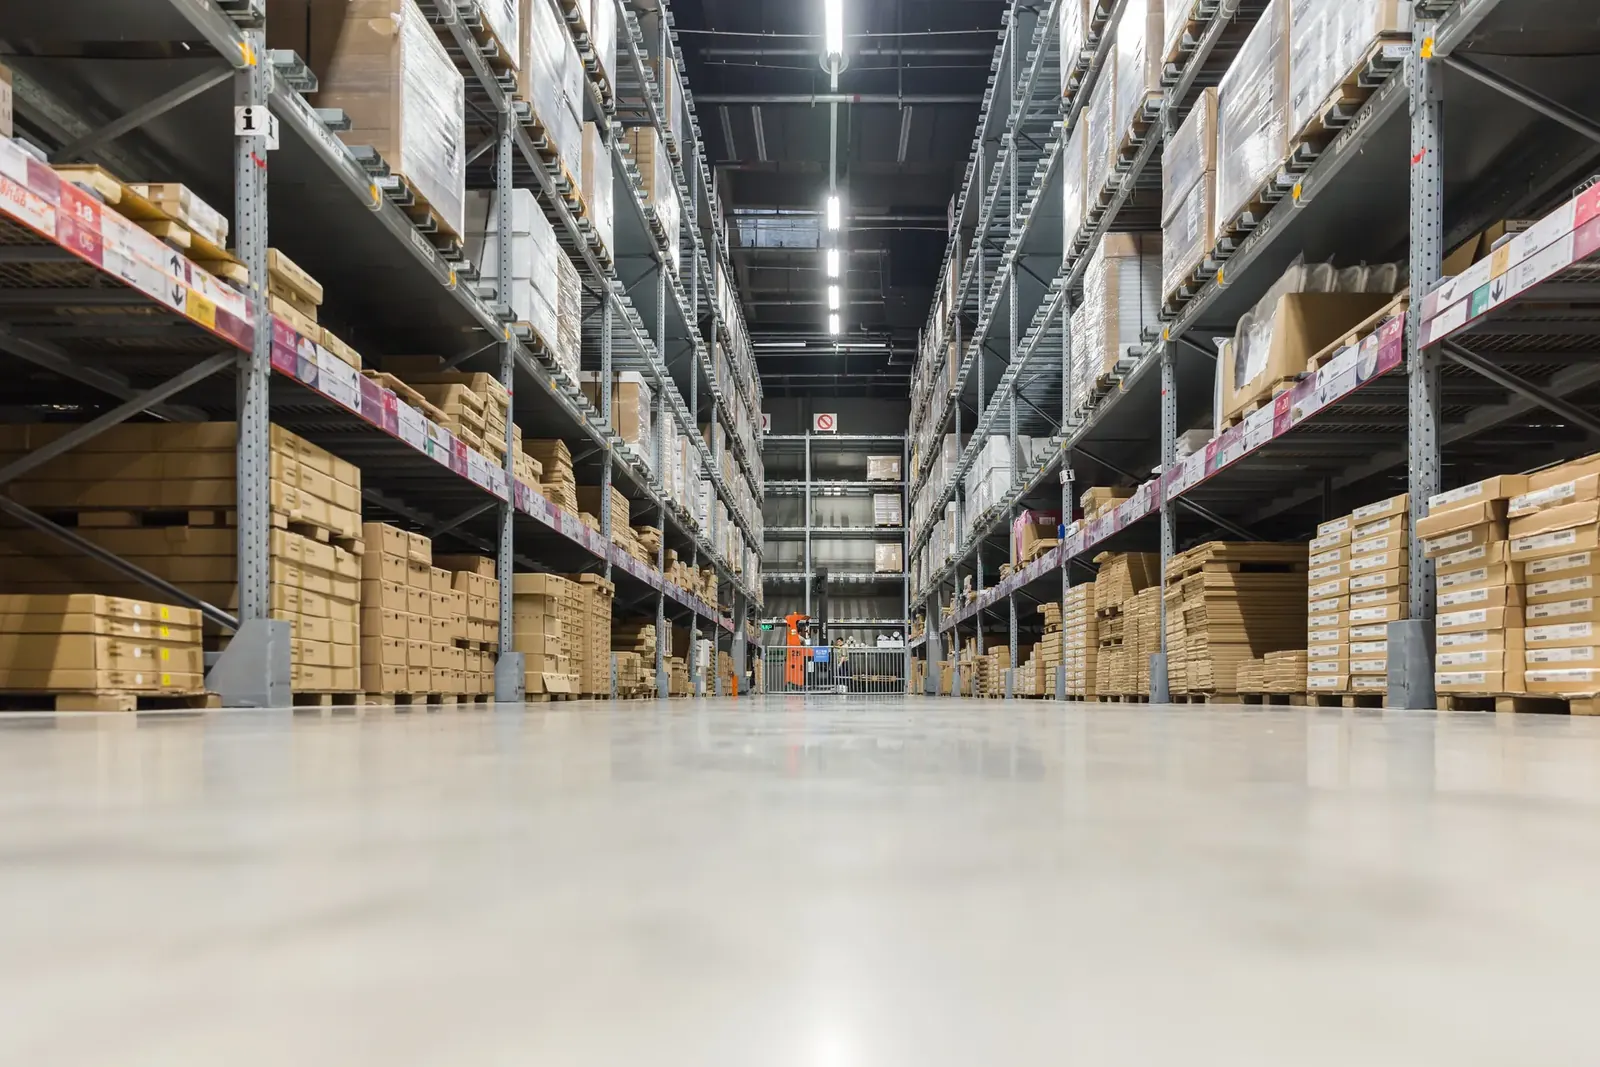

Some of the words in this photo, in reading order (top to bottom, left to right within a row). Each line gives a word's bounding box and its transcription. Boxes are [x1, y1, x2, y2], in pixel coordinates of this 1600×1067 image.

[243, 108, 255, 130] i
[75, 201, 94, 223] 18
[1389, 320, 1400, 335] 20
